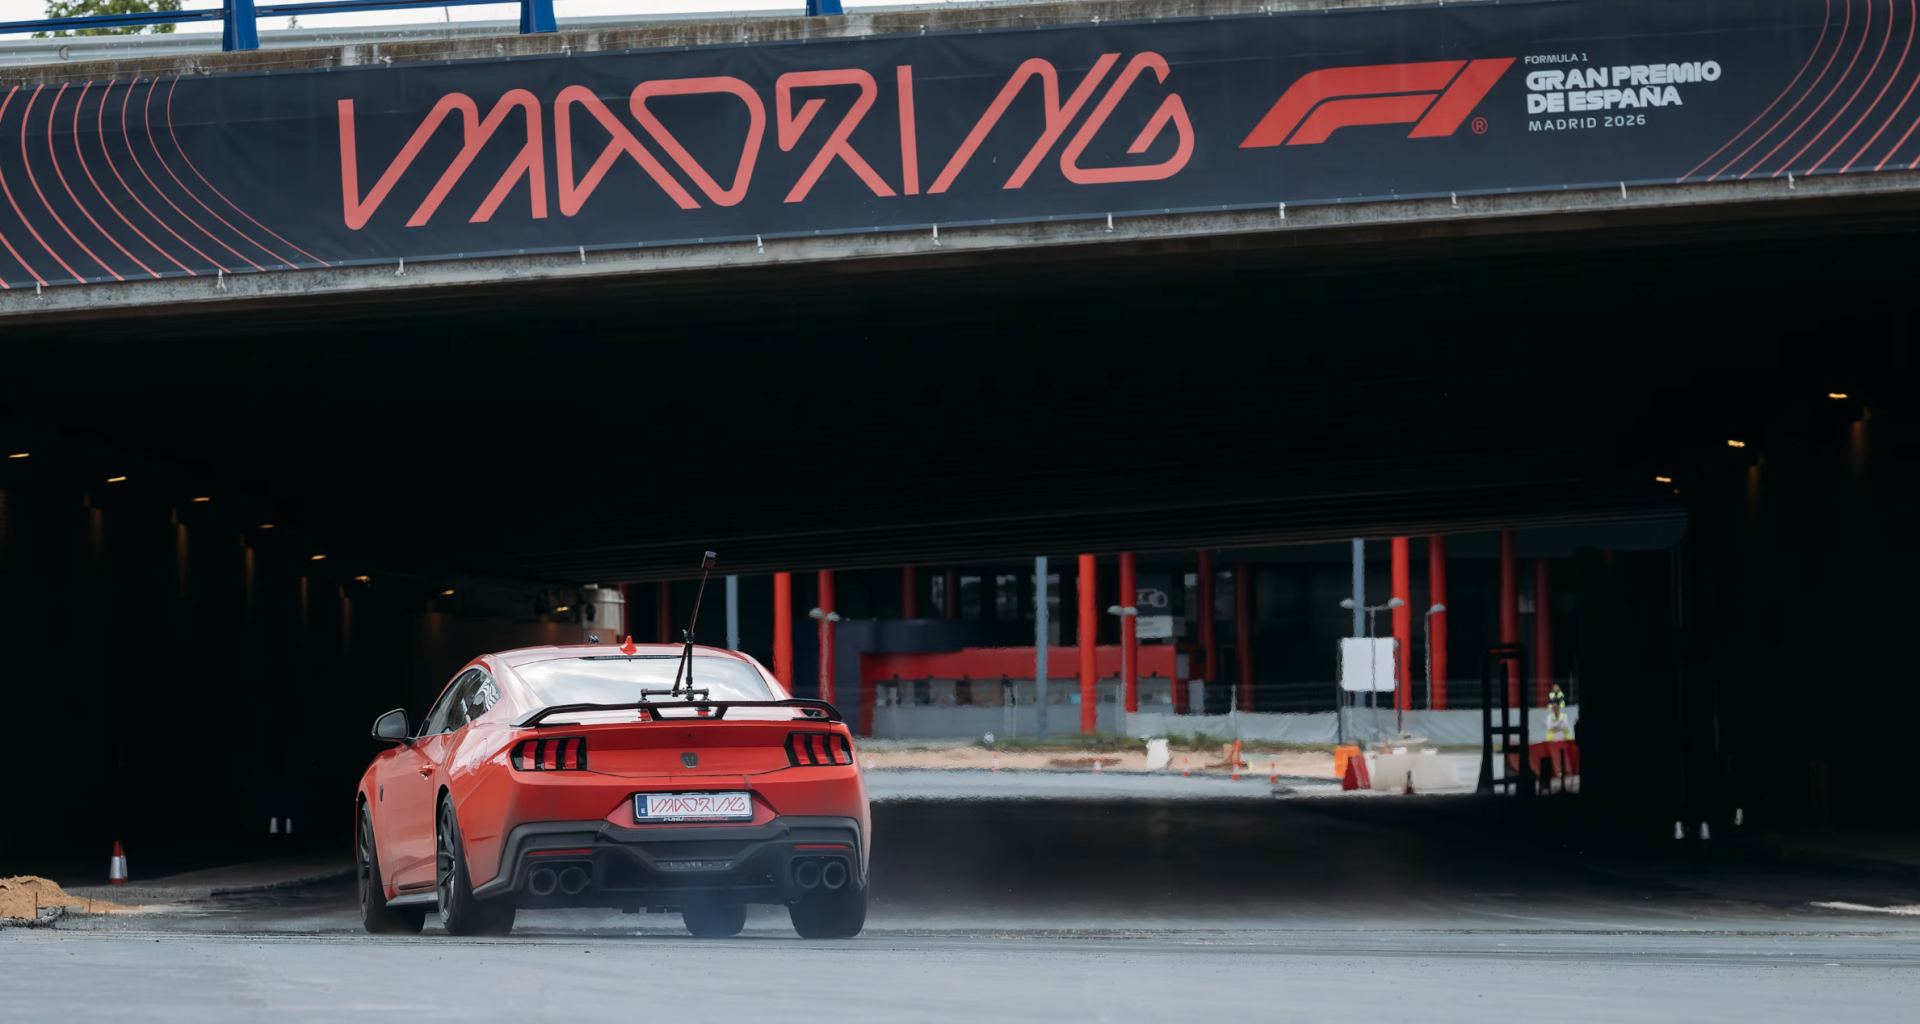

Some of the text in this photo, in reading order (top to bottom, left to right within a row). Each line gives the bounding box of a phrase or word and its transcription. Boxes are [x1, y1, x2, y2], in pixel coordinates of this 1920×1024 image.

[1524, 52, 1589, 64] FORMULA 1
[1526, 60, 1721, 91] GRAN PREMIO
[1239, 57, 1517, 148] F1
[1527, 85, 1683, 114] DE ESPAÑA
[1528, 114, 1646, 132] MADRID 2026
[337, 52, 1195, 231] MADRING
